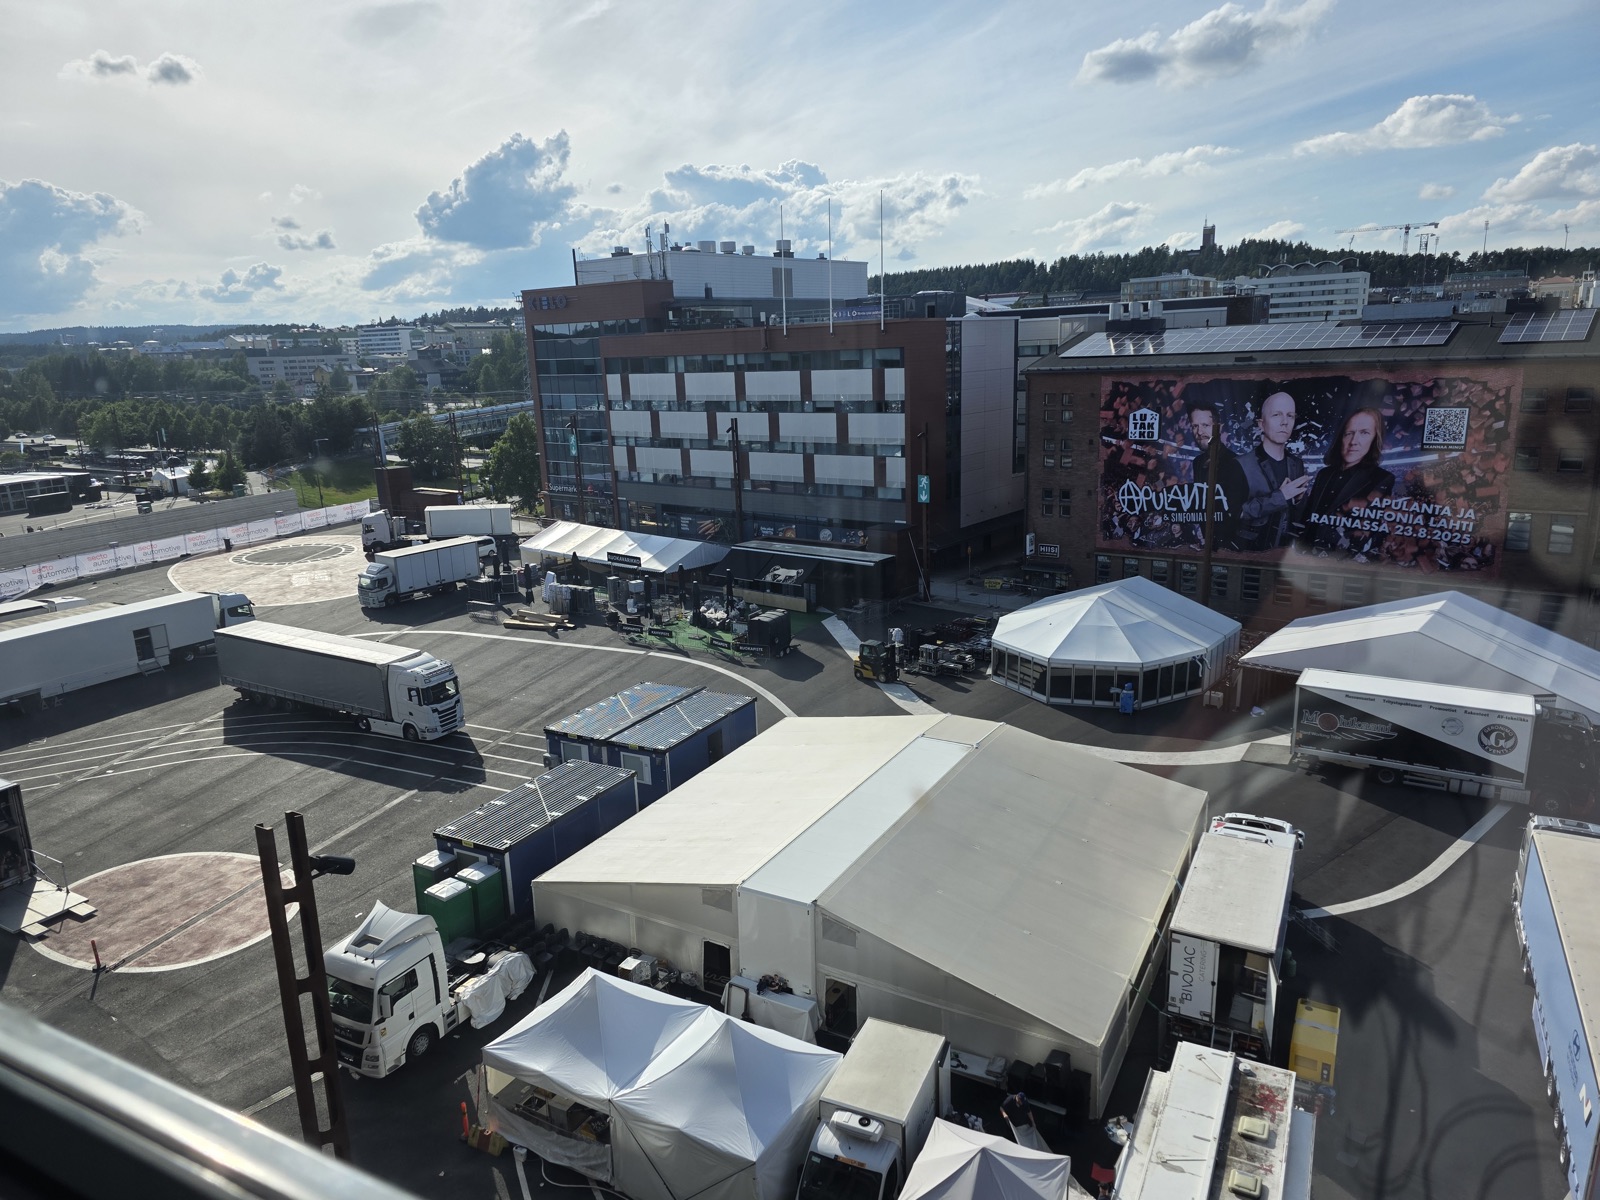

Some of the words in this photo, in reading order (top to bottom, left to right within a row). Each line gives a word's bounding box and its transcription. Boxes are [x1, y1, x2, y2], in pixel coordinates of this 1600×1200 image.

[527, 294, 567, 311] KIELO
[1133, 413, 1147, 421] LU
[1132, 422, 1155, 430] TAK
[548, 482, 579, 493] Supermark
[1118, 478, 1229, 515] APULANTA
[1370, 497, 1451, 516] APULANTA
[1457, 508, 1475, 519] JA
[1163, 513, 1169, 521] &
[1171, 512, 1203, 523] SINFONIA
[1351, 506, 1424, 525] SINFONIA
[1429, 516, 1474, 532] LAHTI
[231, 526, 248, 534] secto
[236, 527, 269, 538] automotive
[1310, 512, 1390, 534] RATINASSA
[1394, 524, 1471, 544] 23.8.2025
[187, 534, 206, 542] secto
[138, 543, 158, 551] secto
[143, 544, 181, 556] automotive
[87, 553, 108, 562] secto
[92, 554, 132, 567] automotive
[31, 564, 54, 574] secto
[37, 565, 79, 580] automotive
[0, 577, 24, 588] motive
[1483, 724, 1514, 737] GERONIMO
[1490, 731, 1506, 748] G
[1485, 746, 1509, 755] EVENTS
[1198, 950, 1207, 982] CATERING
[1181, 946, 1196, 1002] BIVOUAC
[334, 1027, 353, 1039] MAN
